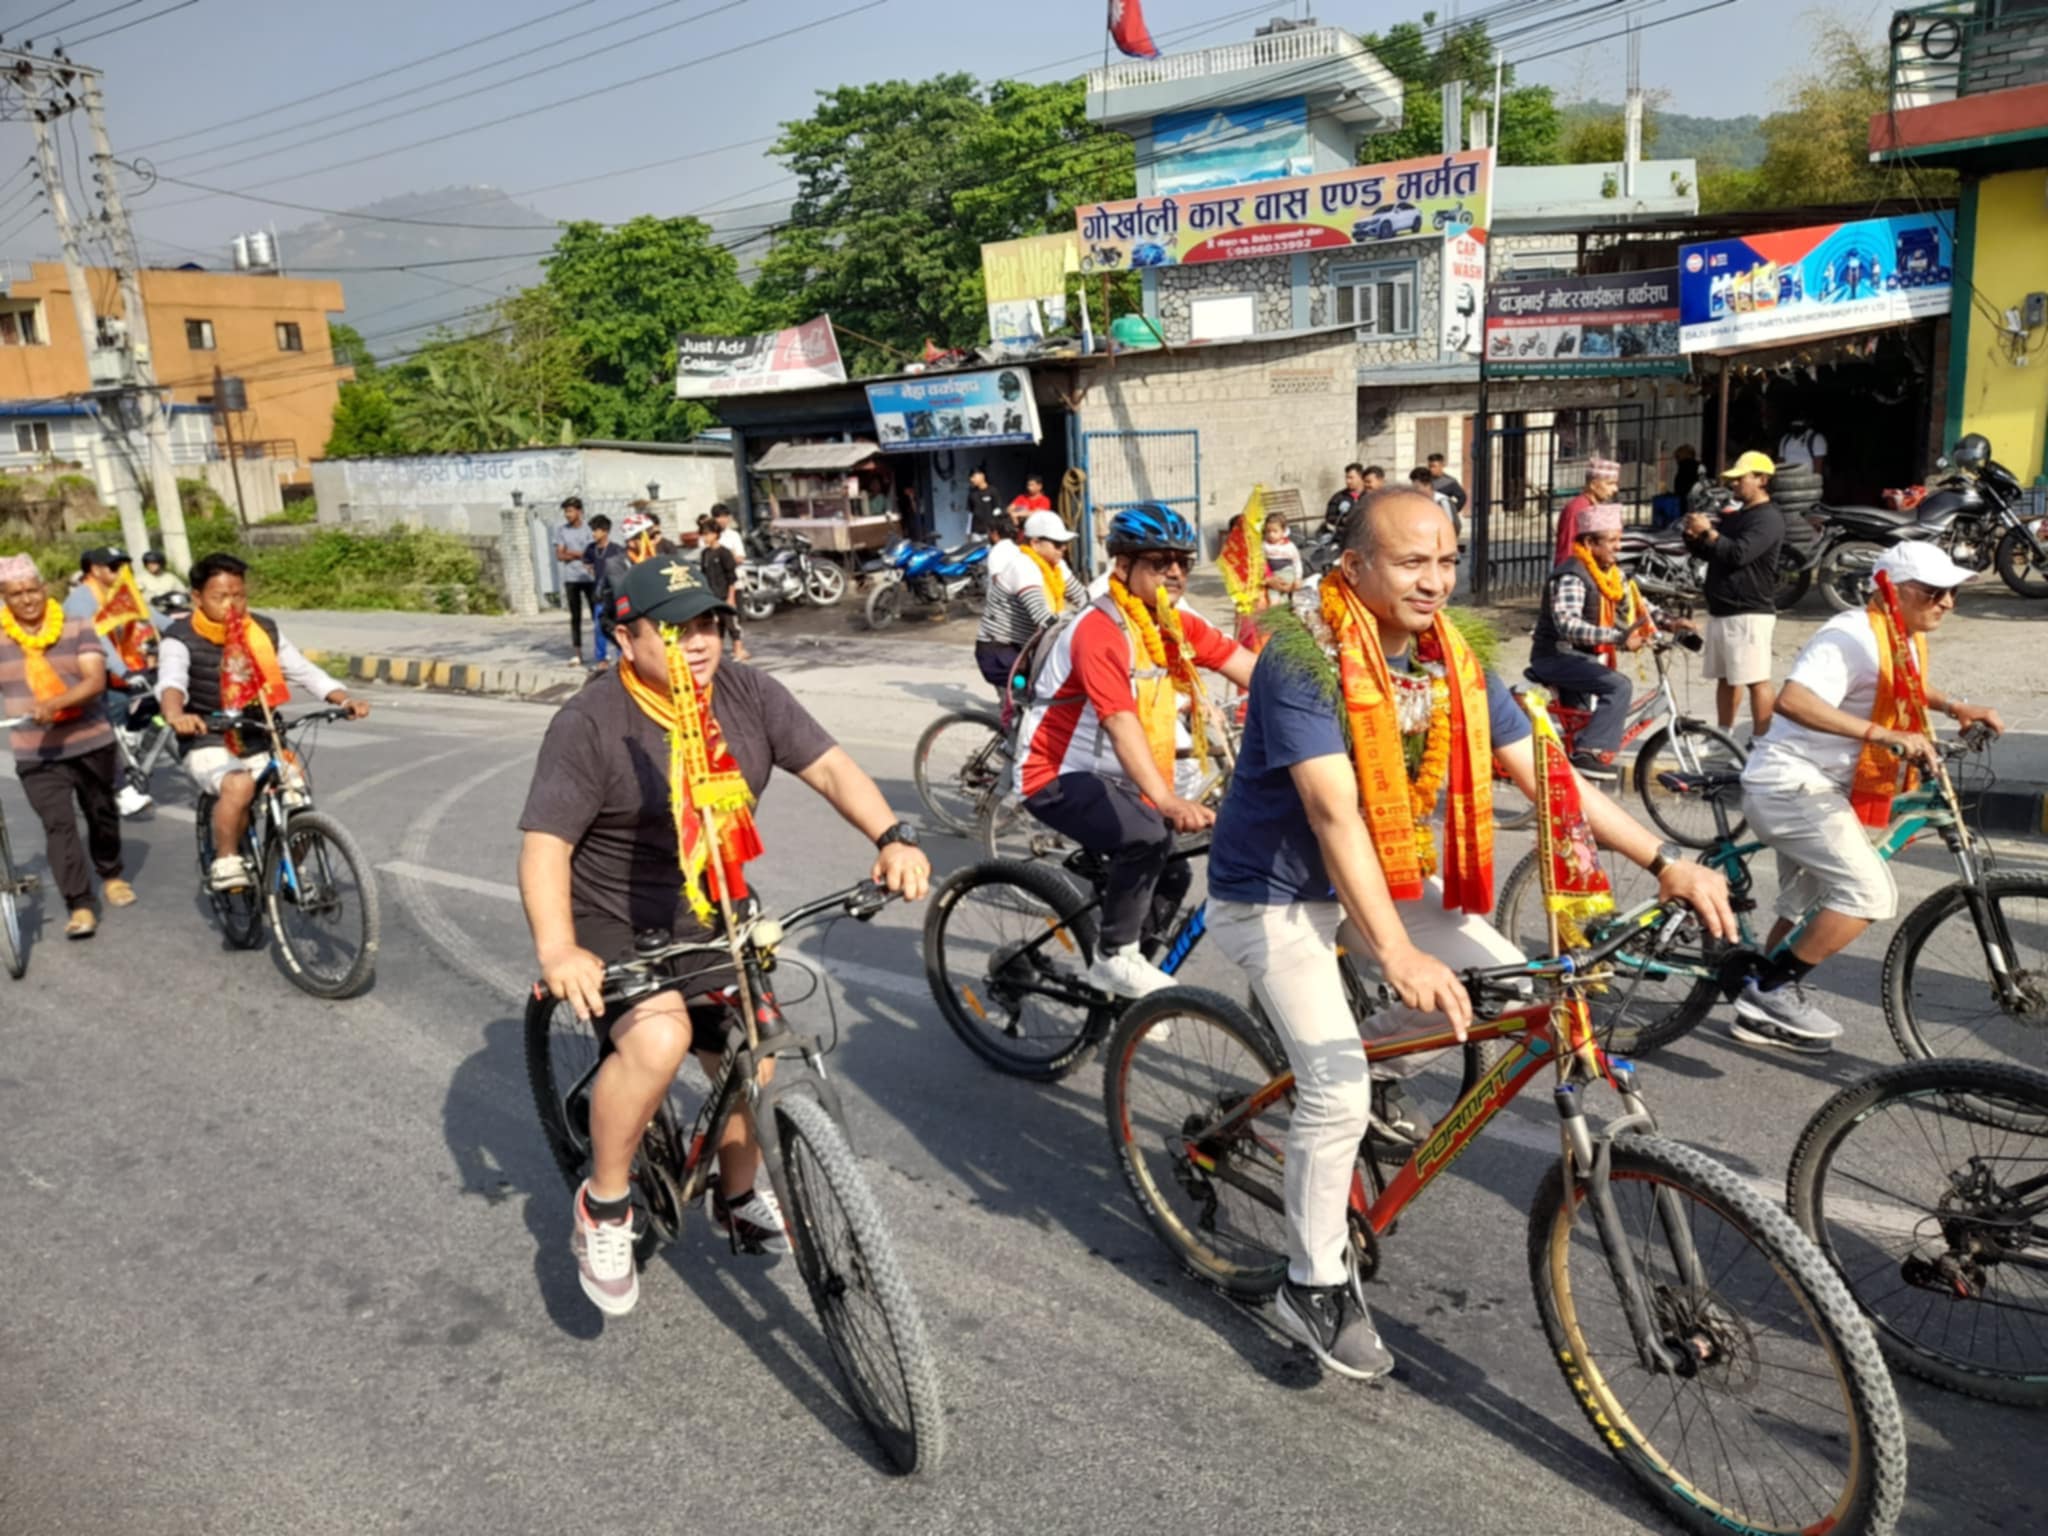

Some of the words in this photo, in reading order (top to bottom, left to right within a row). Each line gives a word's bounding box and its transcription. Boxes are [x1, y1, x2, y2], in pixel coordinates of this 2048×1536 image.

[1082, 197, 1179, 242] गोर्खाली
[1189, 198, 1243, 230] कार
[1254, 187, 1309, 221] वास
[1320, 175, 1386, 212] एण्ड
[1396, 156, 1481, 201] मर्मत
[1452, 262, 1482, 280] WASH
[1456, 240, 1476, 256] CAR
[680, 337, 713, 354] Just
[1415, 1061, 1511, 1178] FORMAT
[1560, 1350, 1627, 1449] MAXXIS
